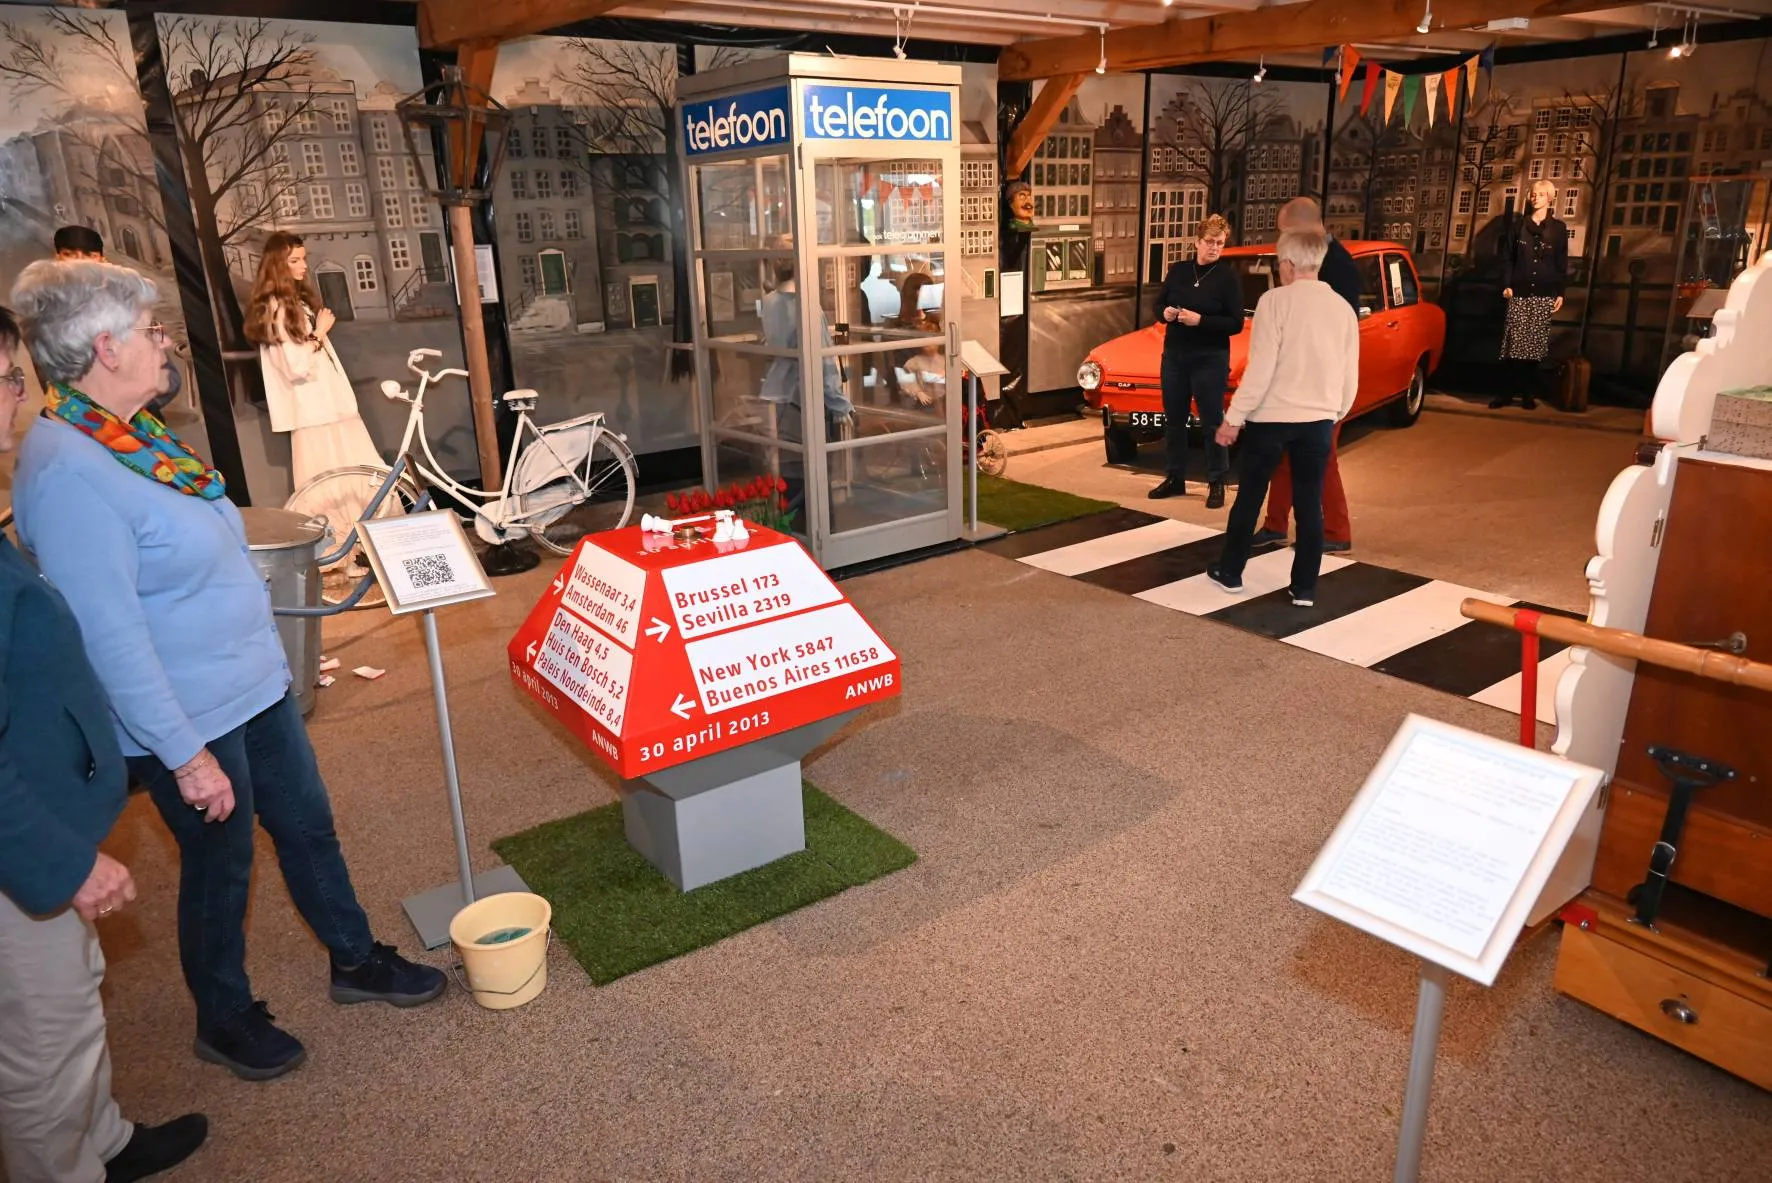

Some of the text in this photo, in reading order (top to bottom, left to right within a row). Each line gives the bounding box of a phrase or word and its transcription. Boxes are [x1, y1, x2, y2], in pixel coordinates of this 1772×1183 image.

[686, 101, 786, 150] telefoon
[809, 91, 949, 139] telefoon
[565, 584, 629, 634] Amsterdam 46
[574, 563, 636, 612] Wassenaar 3,4
[674, 573, 780, 609] Brussel 173
[682, 593, 791, 631] Sevilla 2319
[553, 611, 610, 660] Den Haag 4,5
[545, 632, 624, 700] Huis ten Bosch 5,2
[699, 636, 834, 685] New York 5847
[706, 647, 879, 707] Buenos Aires 11658
[522, 671, 540, 693] april
[541, 687, 559, 711] 2013
[537, 651, 621, 728] Paleis Noordeinde 8,4
[845, 673, 894, 700] ANWB
[592, 729, 619, 761] ANWB
[640, 711, 771, 762] 30 april 2013
